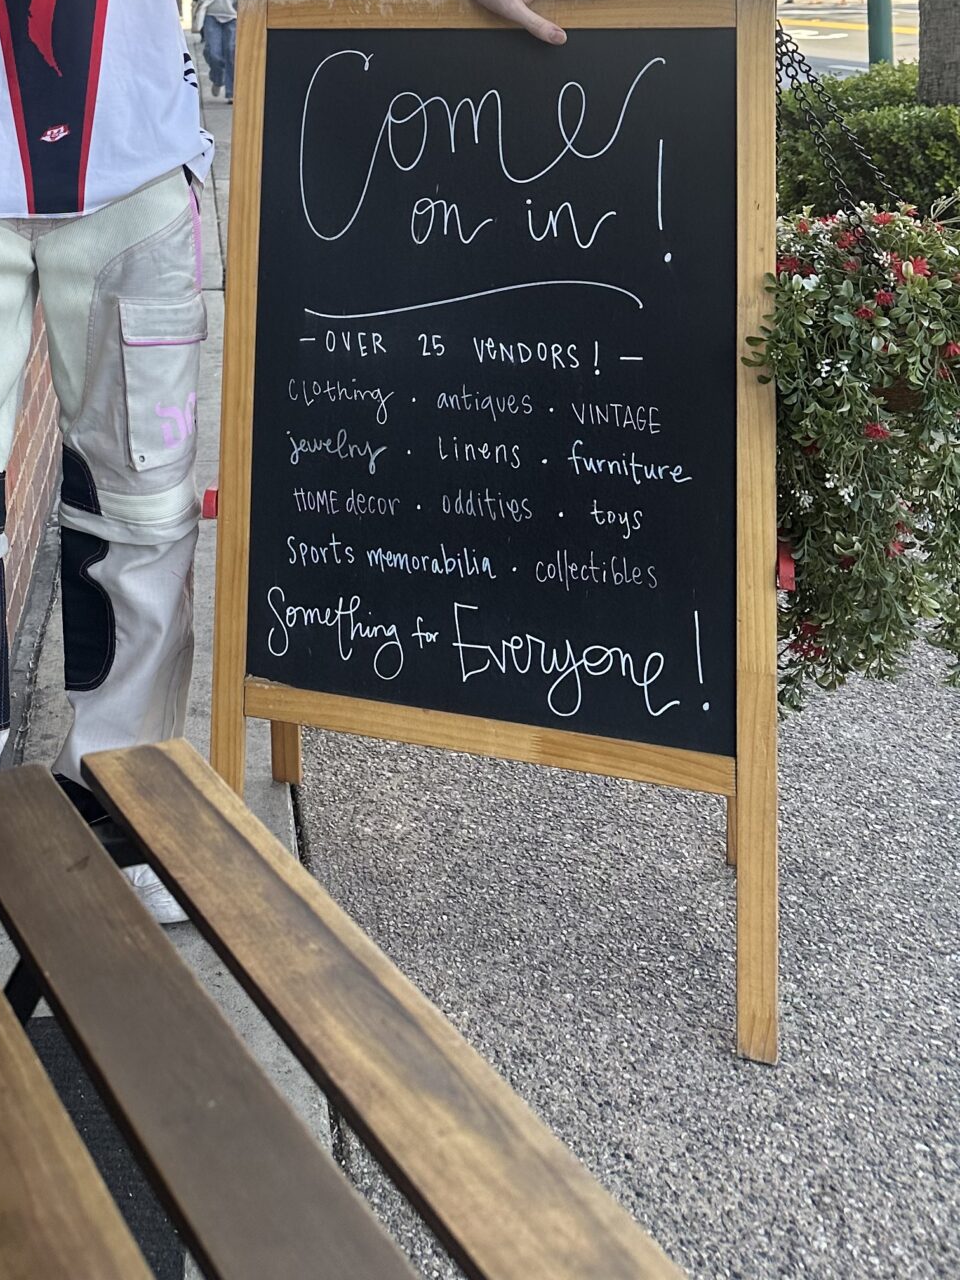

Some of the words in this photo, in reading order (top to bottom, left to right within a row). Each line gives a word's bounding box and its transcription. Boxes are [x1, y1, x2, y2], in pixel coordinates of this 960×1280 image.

[301, 50, 665, 240] Come
[412, 197, 494, 245] on
[417, 334, 445, 357] 25
[436, 384, 534, 422] antiques
[571, 402, 662, 435] VINTAGE
[286, 429, 387, 475] jewelry
[567, 439, 693, 485] furniture
[292, 487, 339, 515] HOME
[345, 488, 401, 516] decor
[441, 488, 533, 522] oddities
[590, 499, 643, 540] toys
[366, 543, 496, 580] memorabilia
[535, 549, 658, 592] collectibles
[267, 585, 404, 681] Something
[411, 615, 439, 650] for
